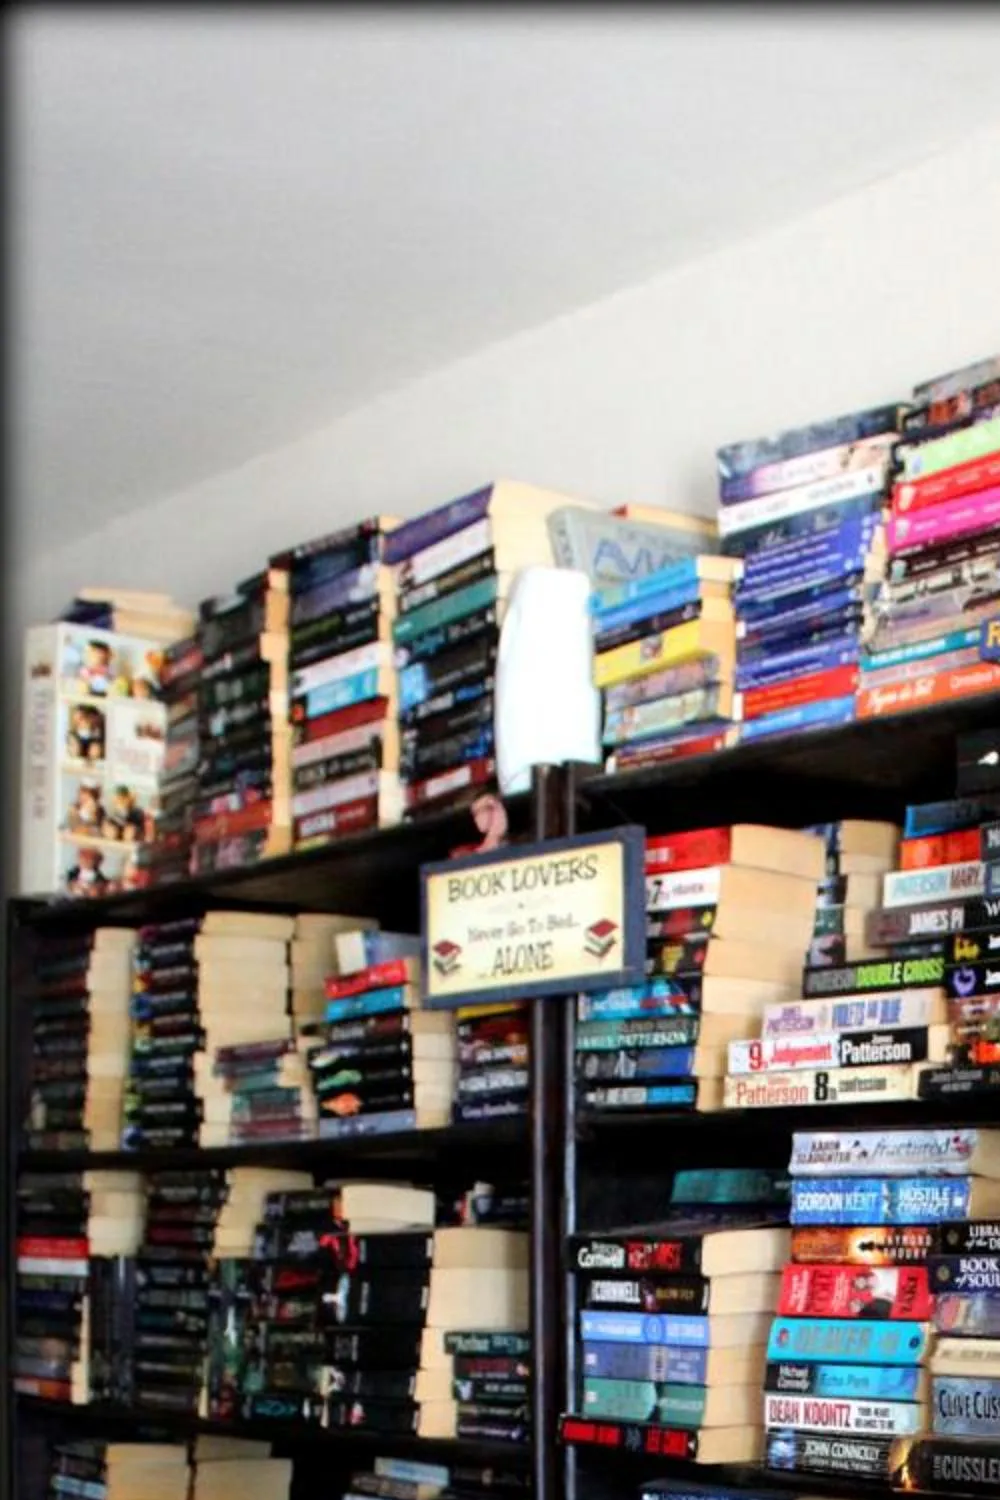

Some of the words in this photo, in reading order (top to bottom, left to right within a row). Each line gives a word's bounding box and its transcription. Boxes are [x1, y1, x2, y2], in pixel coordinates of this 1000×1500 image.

[448, 875, 506, 903] BOOK
[511, 854, 599, 892] LOVERS
[909, 911, 950, 935] JAMES
[903, 956, 945, 984] CROSS
[617, 1030, 689, 1048] PATTERSON
[841, 1039, 912, 1064] Patterson
[736, 1081, 809, 1106] Patterson
[797, 1191, 843, 1212] GORDON
[845, 1190, 880, 1211] KENT
[960, 1256, 999, 1273] BOOK
[769, 1399, 800, 1424] DEAN
[803, 1401, 852, 1427] KOONTZ
